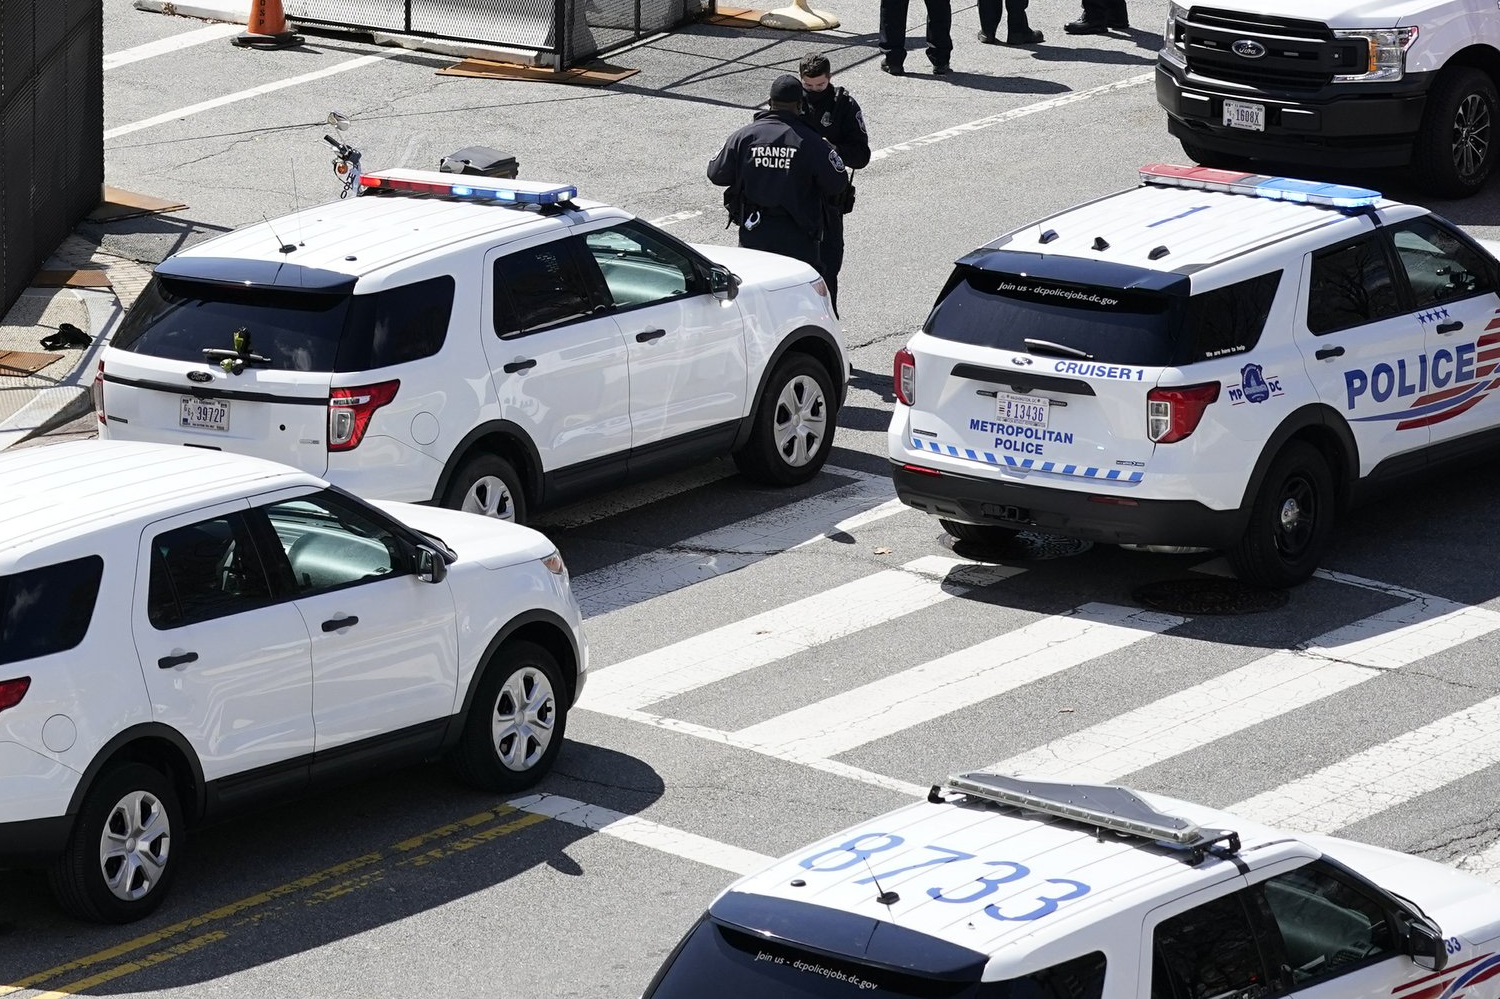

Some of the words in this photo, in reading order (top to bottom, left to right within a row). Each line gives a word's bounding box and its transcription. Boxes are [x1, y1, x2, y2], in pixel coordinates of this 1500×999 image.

[1236, 108, 1259, 124] 1608X
[751, 147, 797, 158] TRANSIT
[755, 158, 790, 168] POLICE
[997, 282, 1016, 291] Join
[1017, 284, 1027, 292] us
[1034, 286, 1118, 306] dcpolicejobs.dc.gov
[1054, 361, 1132, 380] CRUISER
[1136, 370, 1144, 380] 1
[1344, 342, 1475, 410] POLICE
[1229, 389, 1242, 400] MP
[1269, 380, 1282, 392] DC
[196, 406, 225, 422] 3972P
[1014, 404, 1044, 422] 13436
[970, 418, 1074, 444] METROPOLITAN
[994, 438, 1044, 455] POLICE
[798, 832, 1091, 921] 8733
[754, 951, 773, 964] Join
[774, 956, 786, 965] us
[793, 960, 878, 991] dcpolicejobs.dc.gov
